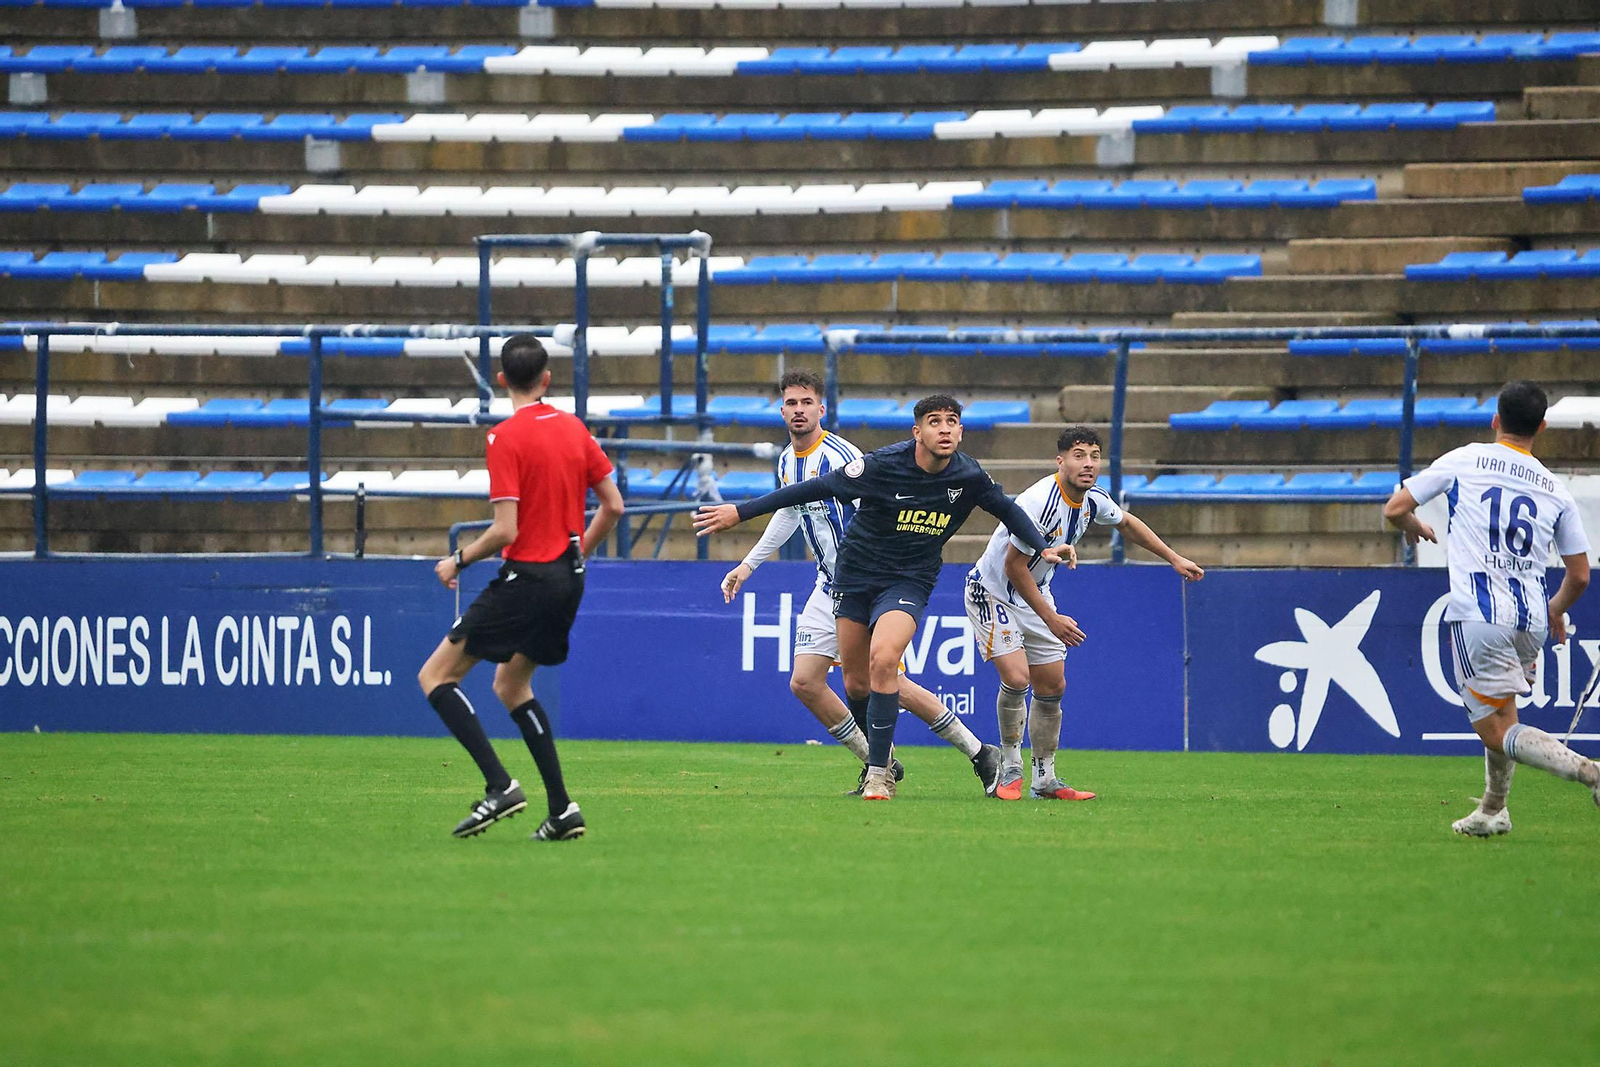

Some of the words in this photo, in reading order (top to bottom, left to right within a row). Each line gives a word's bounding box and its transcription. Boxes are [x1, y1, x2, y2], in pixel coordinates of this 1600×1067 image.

[1476, 456, 1506, 473] IVAN
[1509, 463, 1555, 493] ROMERO
[897, 509, 952, 529] UCAM
[1480, 486, 1538, 558] 16
[1484, 554, 1533, 571] Huelva
[996, 603, 1010, 625] 8
[0, 615, 151, 687] CCIONES
[160, 615, 206, 686] LA
[214, 615, 322, 687] CINTA
[330, 615, 392, 686] S.L.
[742, 592, 975, 676] Hva
